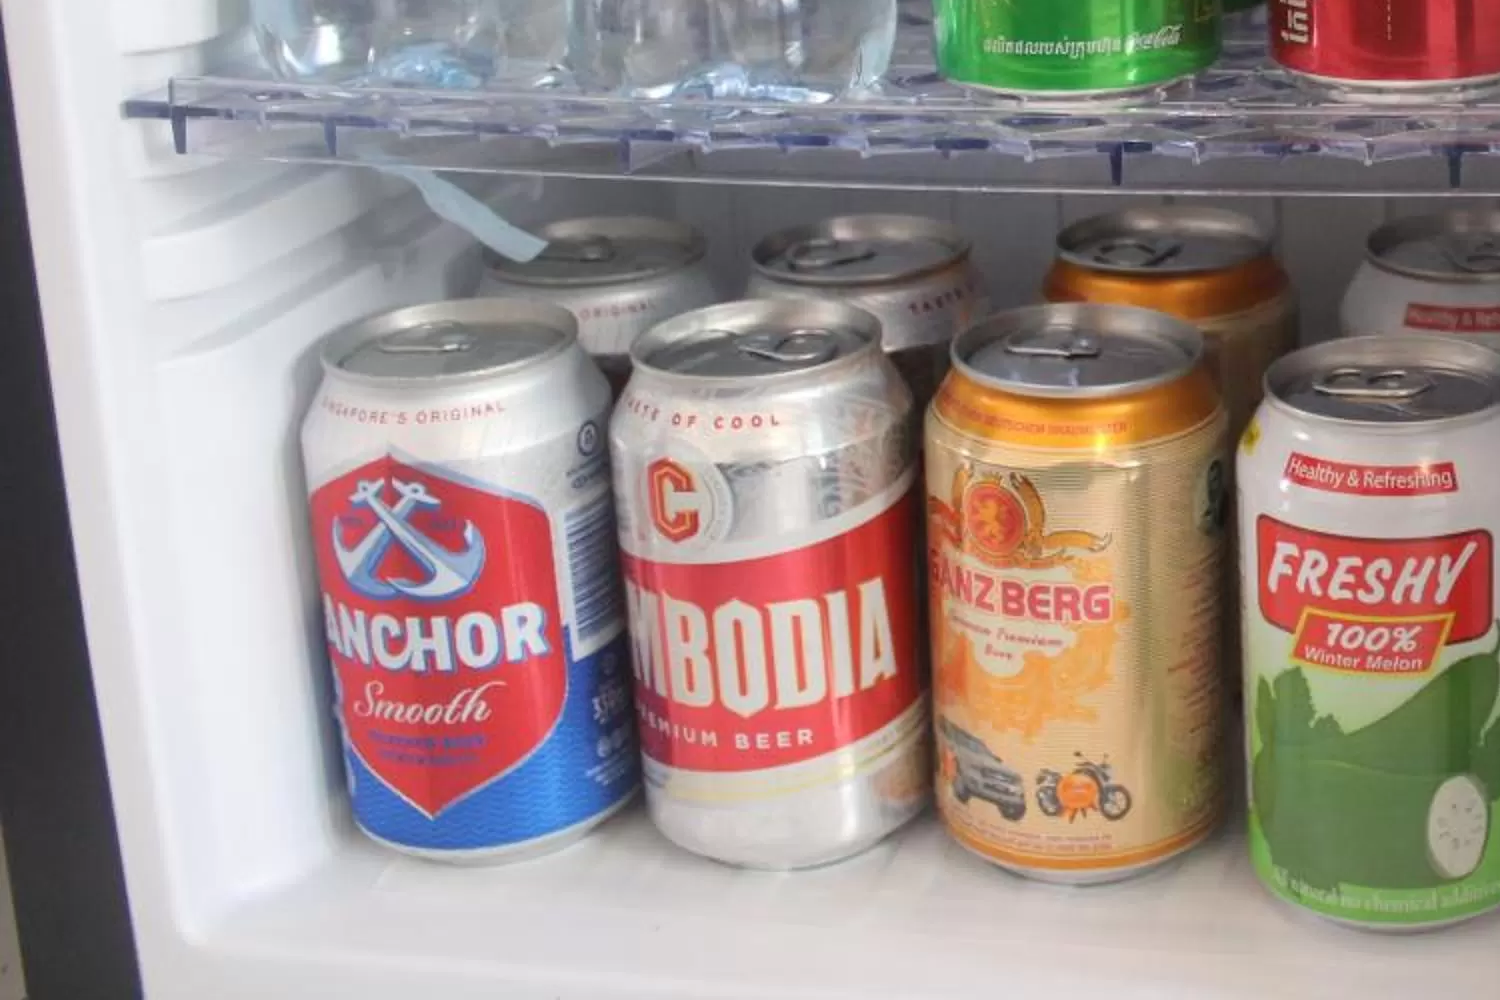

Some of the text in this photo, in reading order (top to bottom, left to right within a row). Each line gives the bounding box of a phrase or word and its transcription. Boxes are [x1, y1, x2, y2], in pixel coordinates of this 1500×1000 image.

[415, 400, 507, 426] ORIGINAL
[671, 410, 698, 428] OF
[713, 413, 781, 430] COOL
[1289, 456, 1454, 490] Healthy & Refreshing
[1267, 541, 1478, 606] FRESHY
[323, 591, 549, 672] ANCHOR
[625, 576, 897, 718] MBODIA
[1326, 622, 1422, 653] 100%
[1304, 645, 1423, 672] Winter Melon
[353, 680, 508, 725] Smooth
[735, 728, 813, 750] BEER
